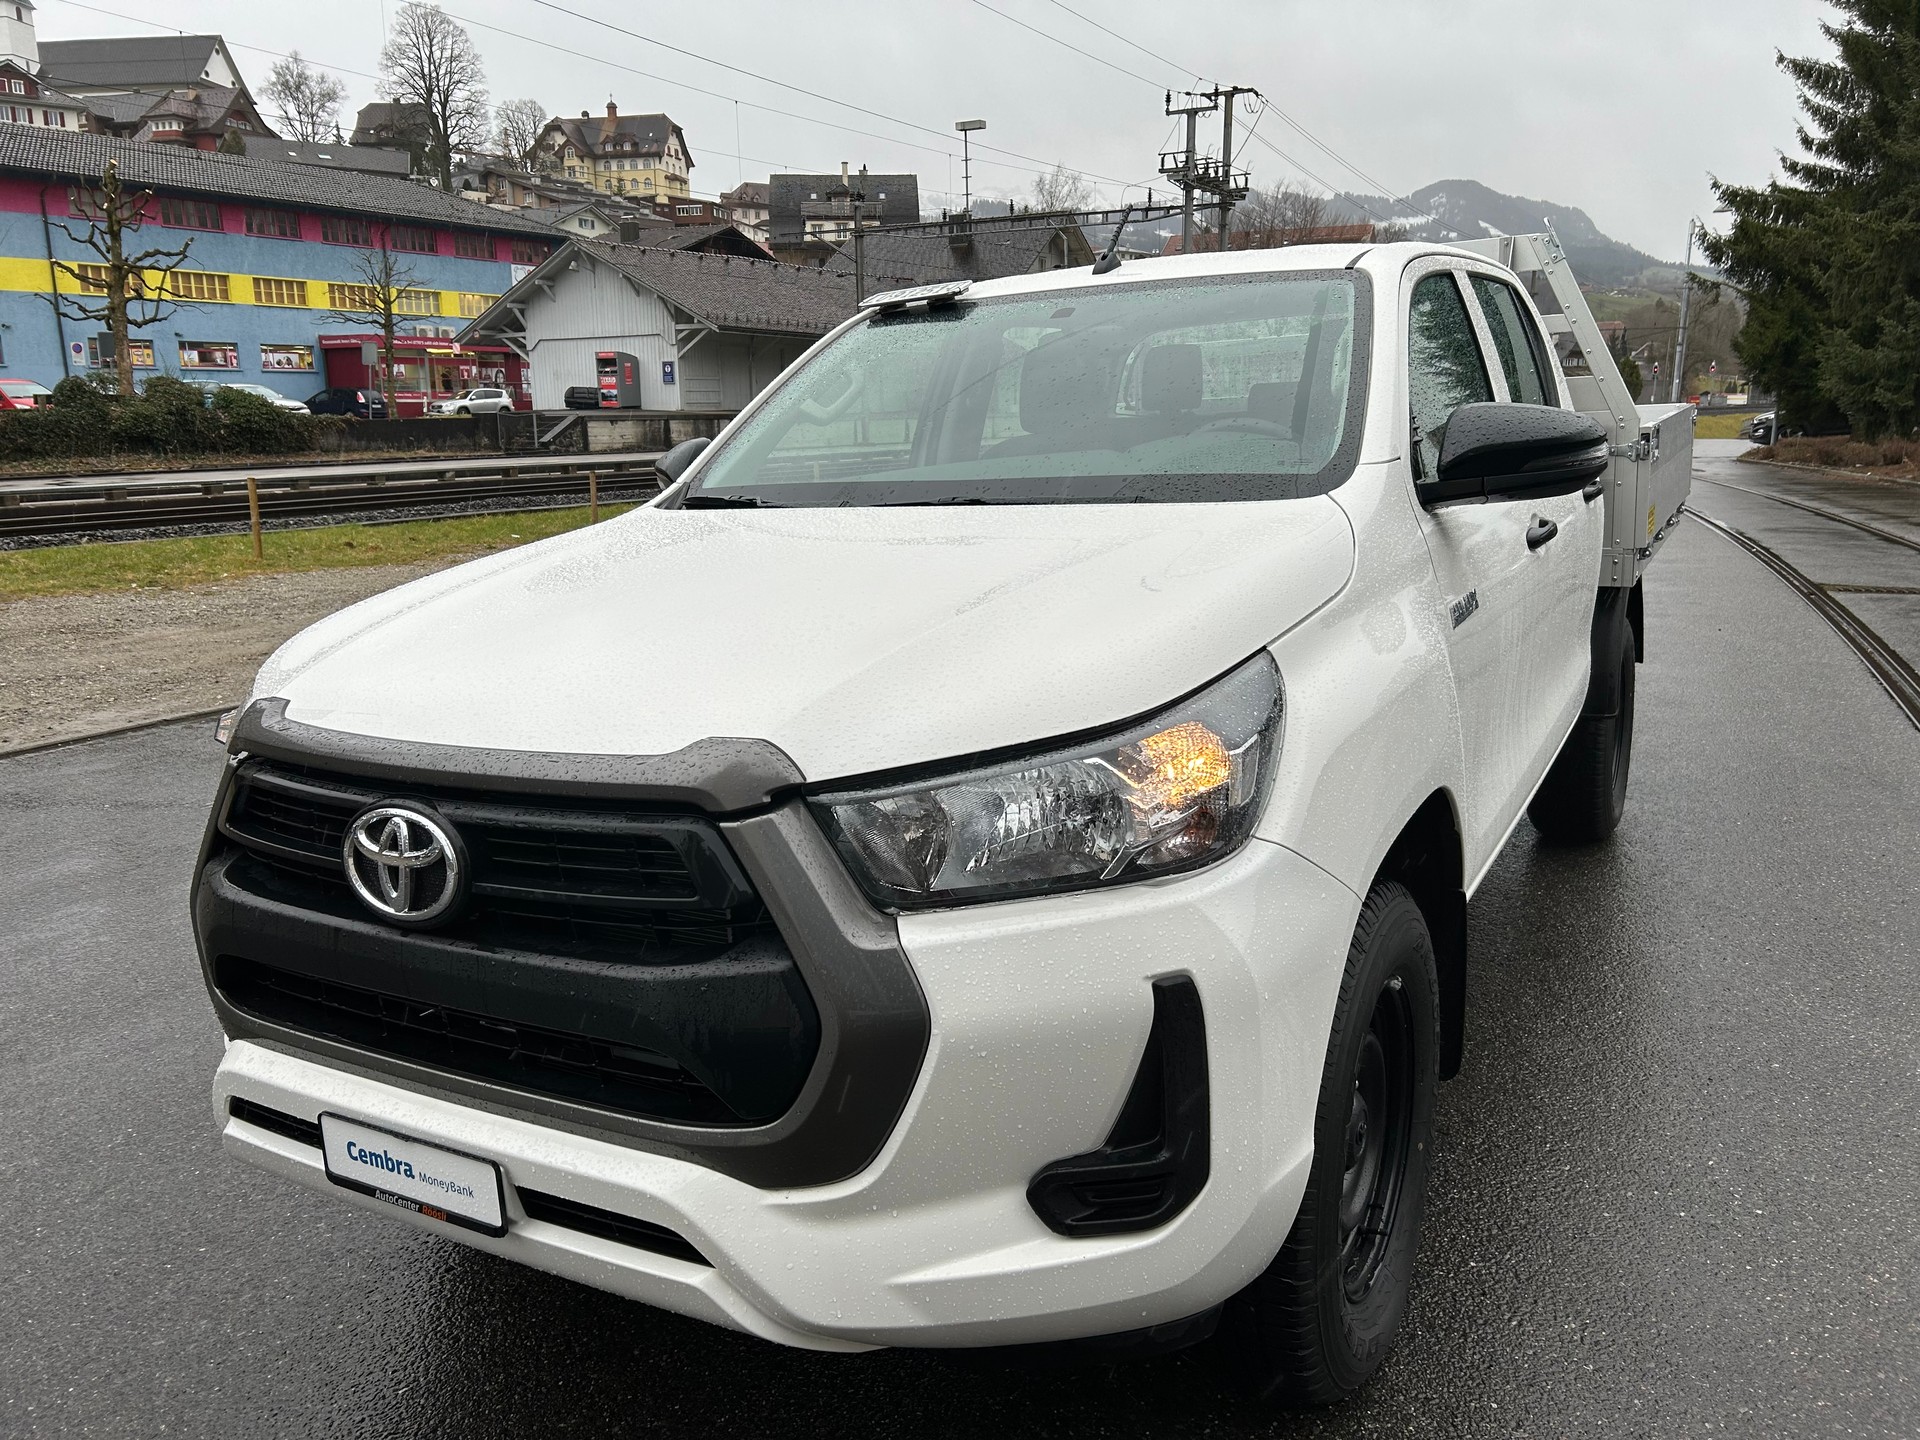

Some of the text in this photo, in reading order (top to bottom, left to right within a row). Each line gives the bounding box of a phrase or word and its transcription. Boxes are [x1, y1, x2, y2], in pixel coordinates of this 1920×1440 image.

[346, 1141, 475, 1198] Cembra MoneyBank
[375, 1189, 420, 1212] AutoCenter
